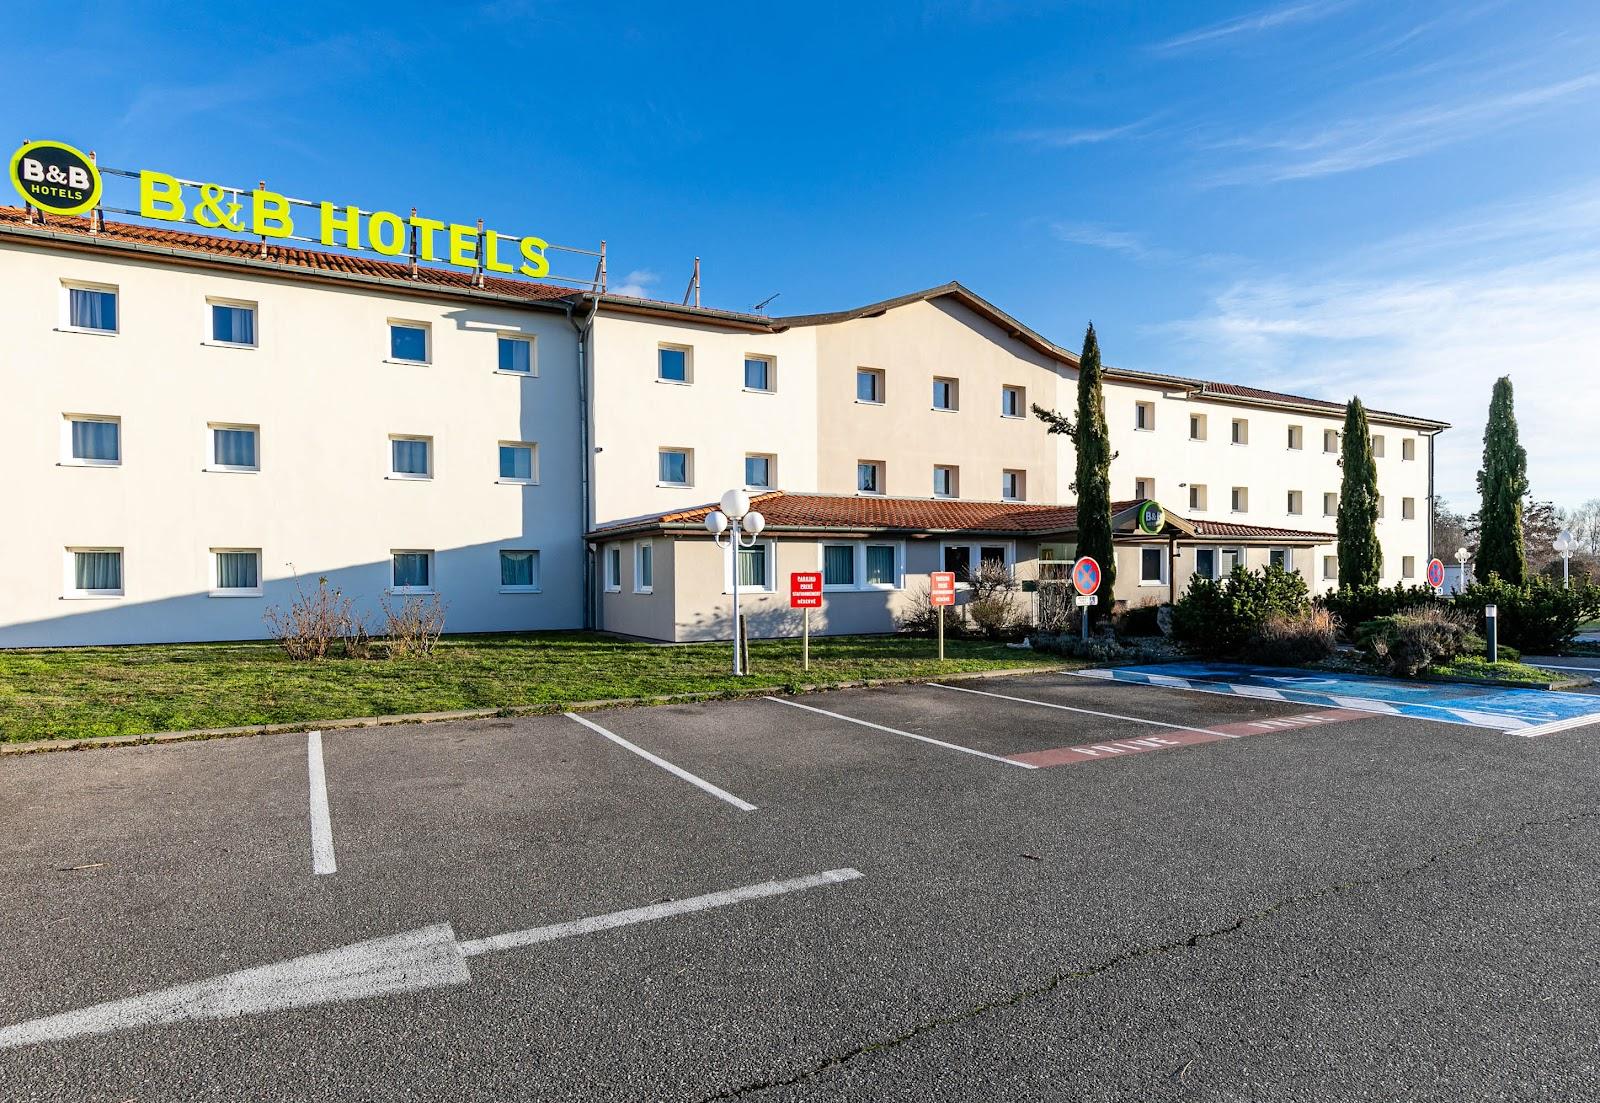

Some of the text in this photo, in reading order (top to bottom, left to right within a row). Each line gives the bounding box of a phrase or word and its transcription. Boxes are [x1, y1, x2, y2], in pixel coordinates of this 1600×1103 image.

[24, 158, 90, 190] B&B
[31, 184, 82, 200] HOTELS
[140, 170, 550, 278] B&B HOTELS
